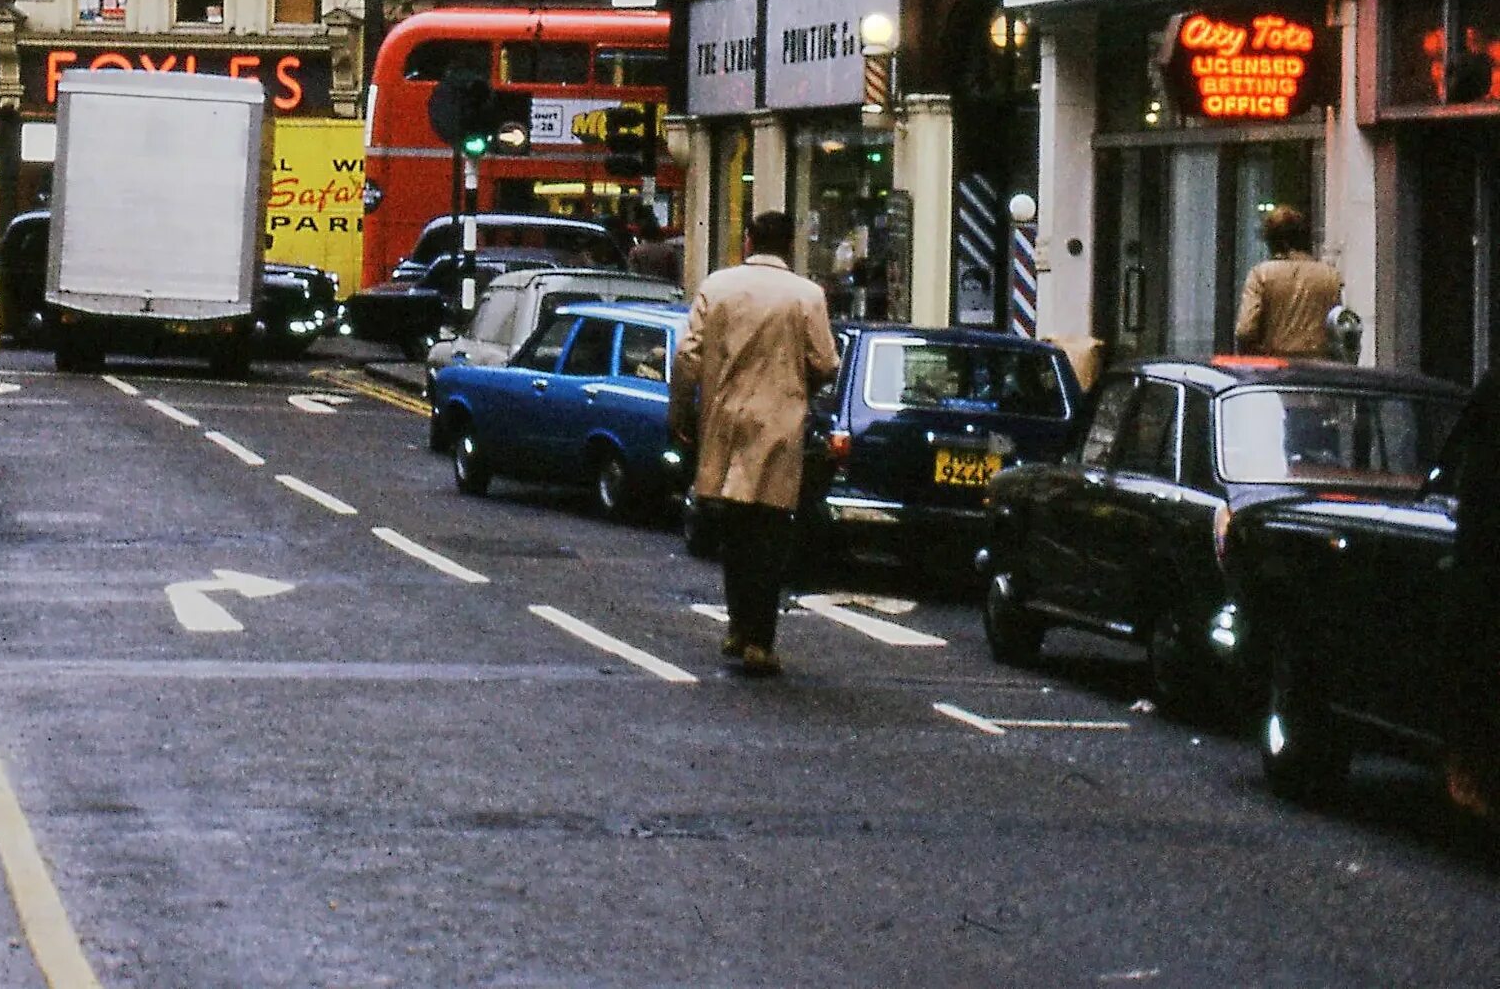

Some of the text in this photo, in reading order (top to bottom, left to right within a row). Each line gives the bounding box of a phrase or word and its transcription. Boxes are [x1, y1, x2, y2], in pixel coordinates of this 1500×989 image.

[1181, 13, 1314, 57] City Tote
[1192, 56, 1304, 76] LICENSED
[1199, 77, 1297, 95] BETTING
[1202, 96, 1290, 117] OFFICE
[273, 158, 292, 171] L
[271, 216, 363, 232] PAR
